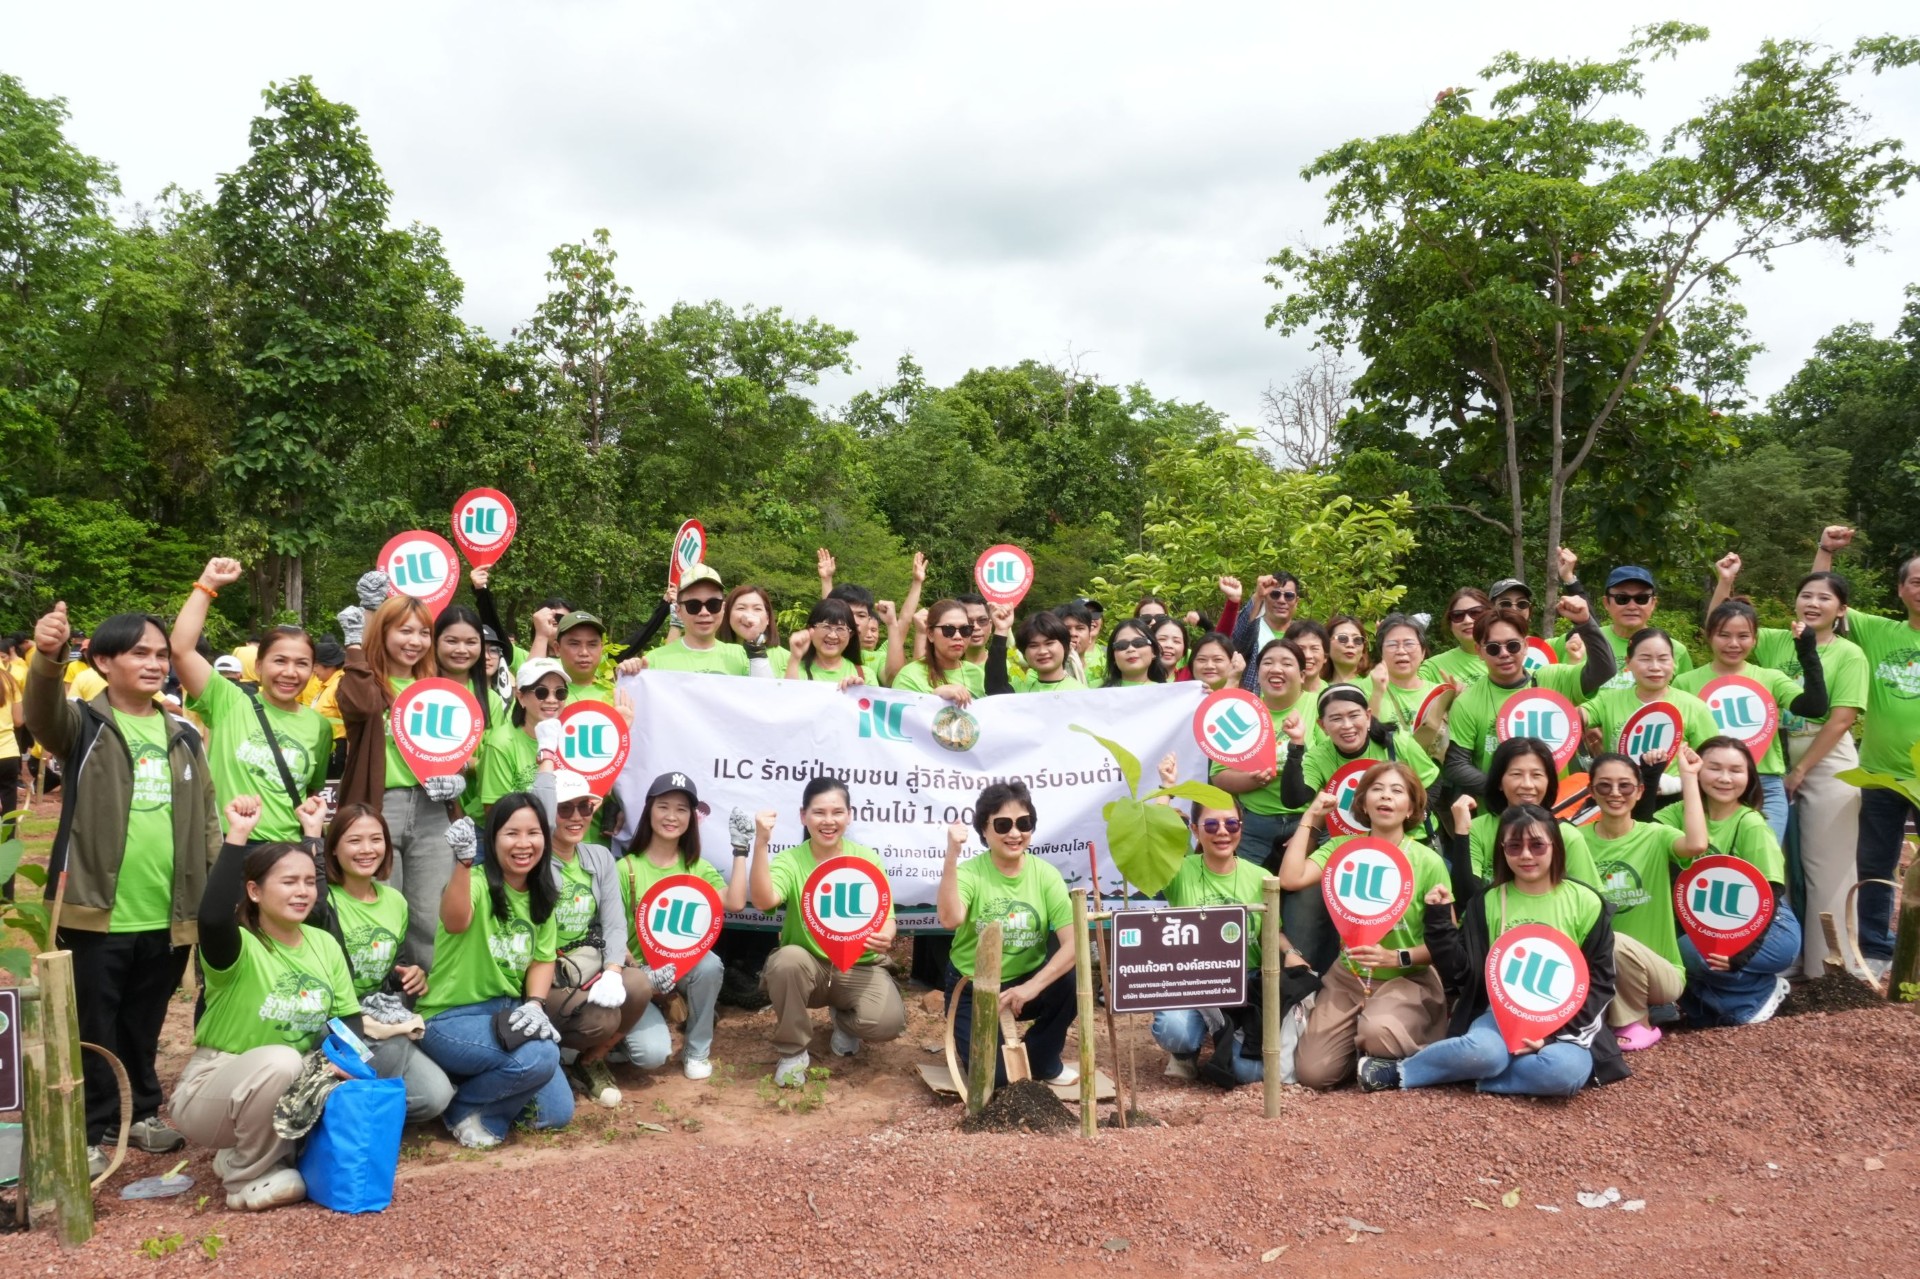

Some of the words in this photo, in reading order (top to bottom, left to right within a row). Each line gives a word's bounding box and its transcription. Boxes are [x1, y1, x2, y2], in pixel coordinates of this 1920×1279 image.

[423, 588, 449, 604] RATORIES
[394, 707, 415, 755] INTERNATIONAL
[415, 750, 465, 763] LABORATORIES
[584, 766, 616, 781] ORATORIES
[713, 758, 754, 780] ILC
[923, 805, 976, 829] 1,00
[905, 867, 919, 877] 22
[921, 867, 943, 880] มิถุน
[1322, 866, 1342, 916] INTERNATIONAL
[1343, 912, 1392, 926] LABORATORIES
[803, 892, 826, 937] INTERNATIONAL
[826, 927, 874, 942] LABORATORIES
[1676, 883, 1697, 929] INTERNATIONAL
[1697, 926, 1751, 939] LABORATORIES
[638, 902, 654, 950] INTERNATIONAL
[654, 946, 701, 959] LABORATORIES
[1162, 917, 1200, 946] สัก
[1119, 960, 1174, 977] คุณแก้วตา
[1489, 947, 1505, 1003] INTERNATIONAL
[1504, 1002, 1558, 1023] LABORATORIES
